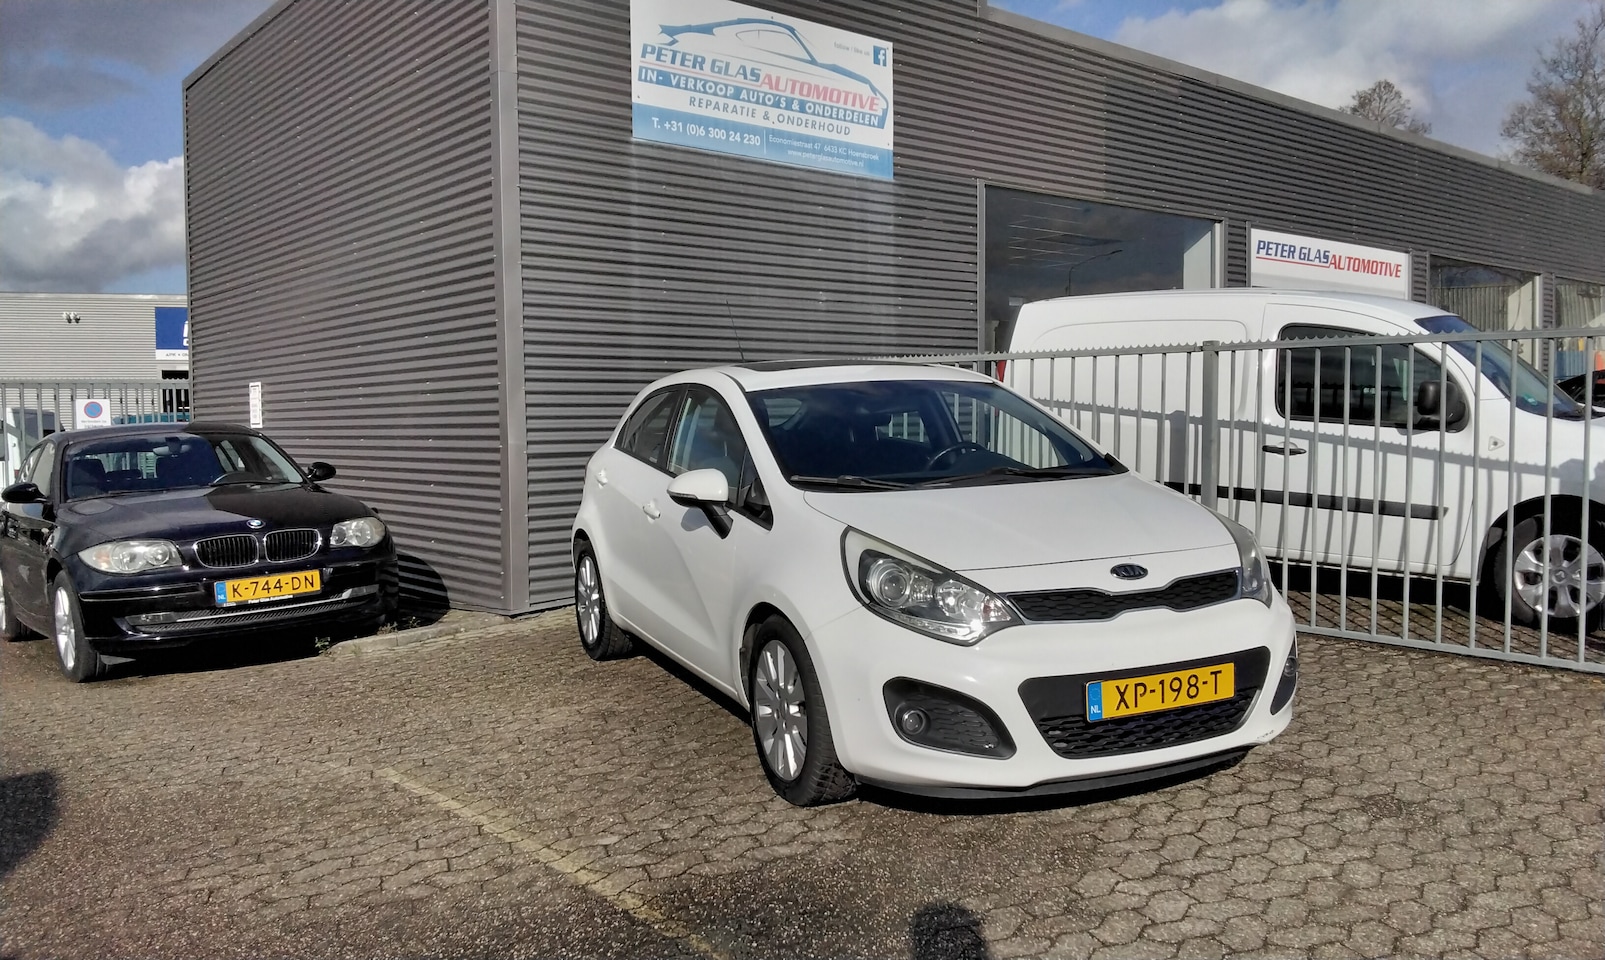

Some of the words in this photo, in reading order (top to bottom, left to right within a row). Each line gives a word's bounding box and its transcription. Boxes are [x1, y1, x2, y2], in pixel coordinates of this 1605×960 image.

[641, 43, 706, 71] PETER
[670, 74, 734, 96] VERKOOP
[740, 89, 786, 108] AUTO'S
[792, 100, 800, 111] &
[806, 103, 879, 126] ONDERDELEN
[689, 96, 756, 118] REPARATIE
[762, 110, 770, 120] &
[777, 114, 850, 136] ONDERHOUD
[652, 117, 660, 128] T.
[664, 120, 683, 132] +31
[686, 123, 706, 137] (0)6
[708, 127, 726, 140] 300
[729, 131, 741, 142] 24
[743, 134, 760, 146] 230
[769, 134, 813, 149] Economiestraat
[838, 147, 847, 155] KC
[848, 149, 879, 161] Hoensbroek
[1256, 240, 1296, 259] PETER
[232, 575, 314, 598] K-744-DN
[1090, 705, 1101, 714] NL
[1115, 670, 1222, 711] XP-198-T
